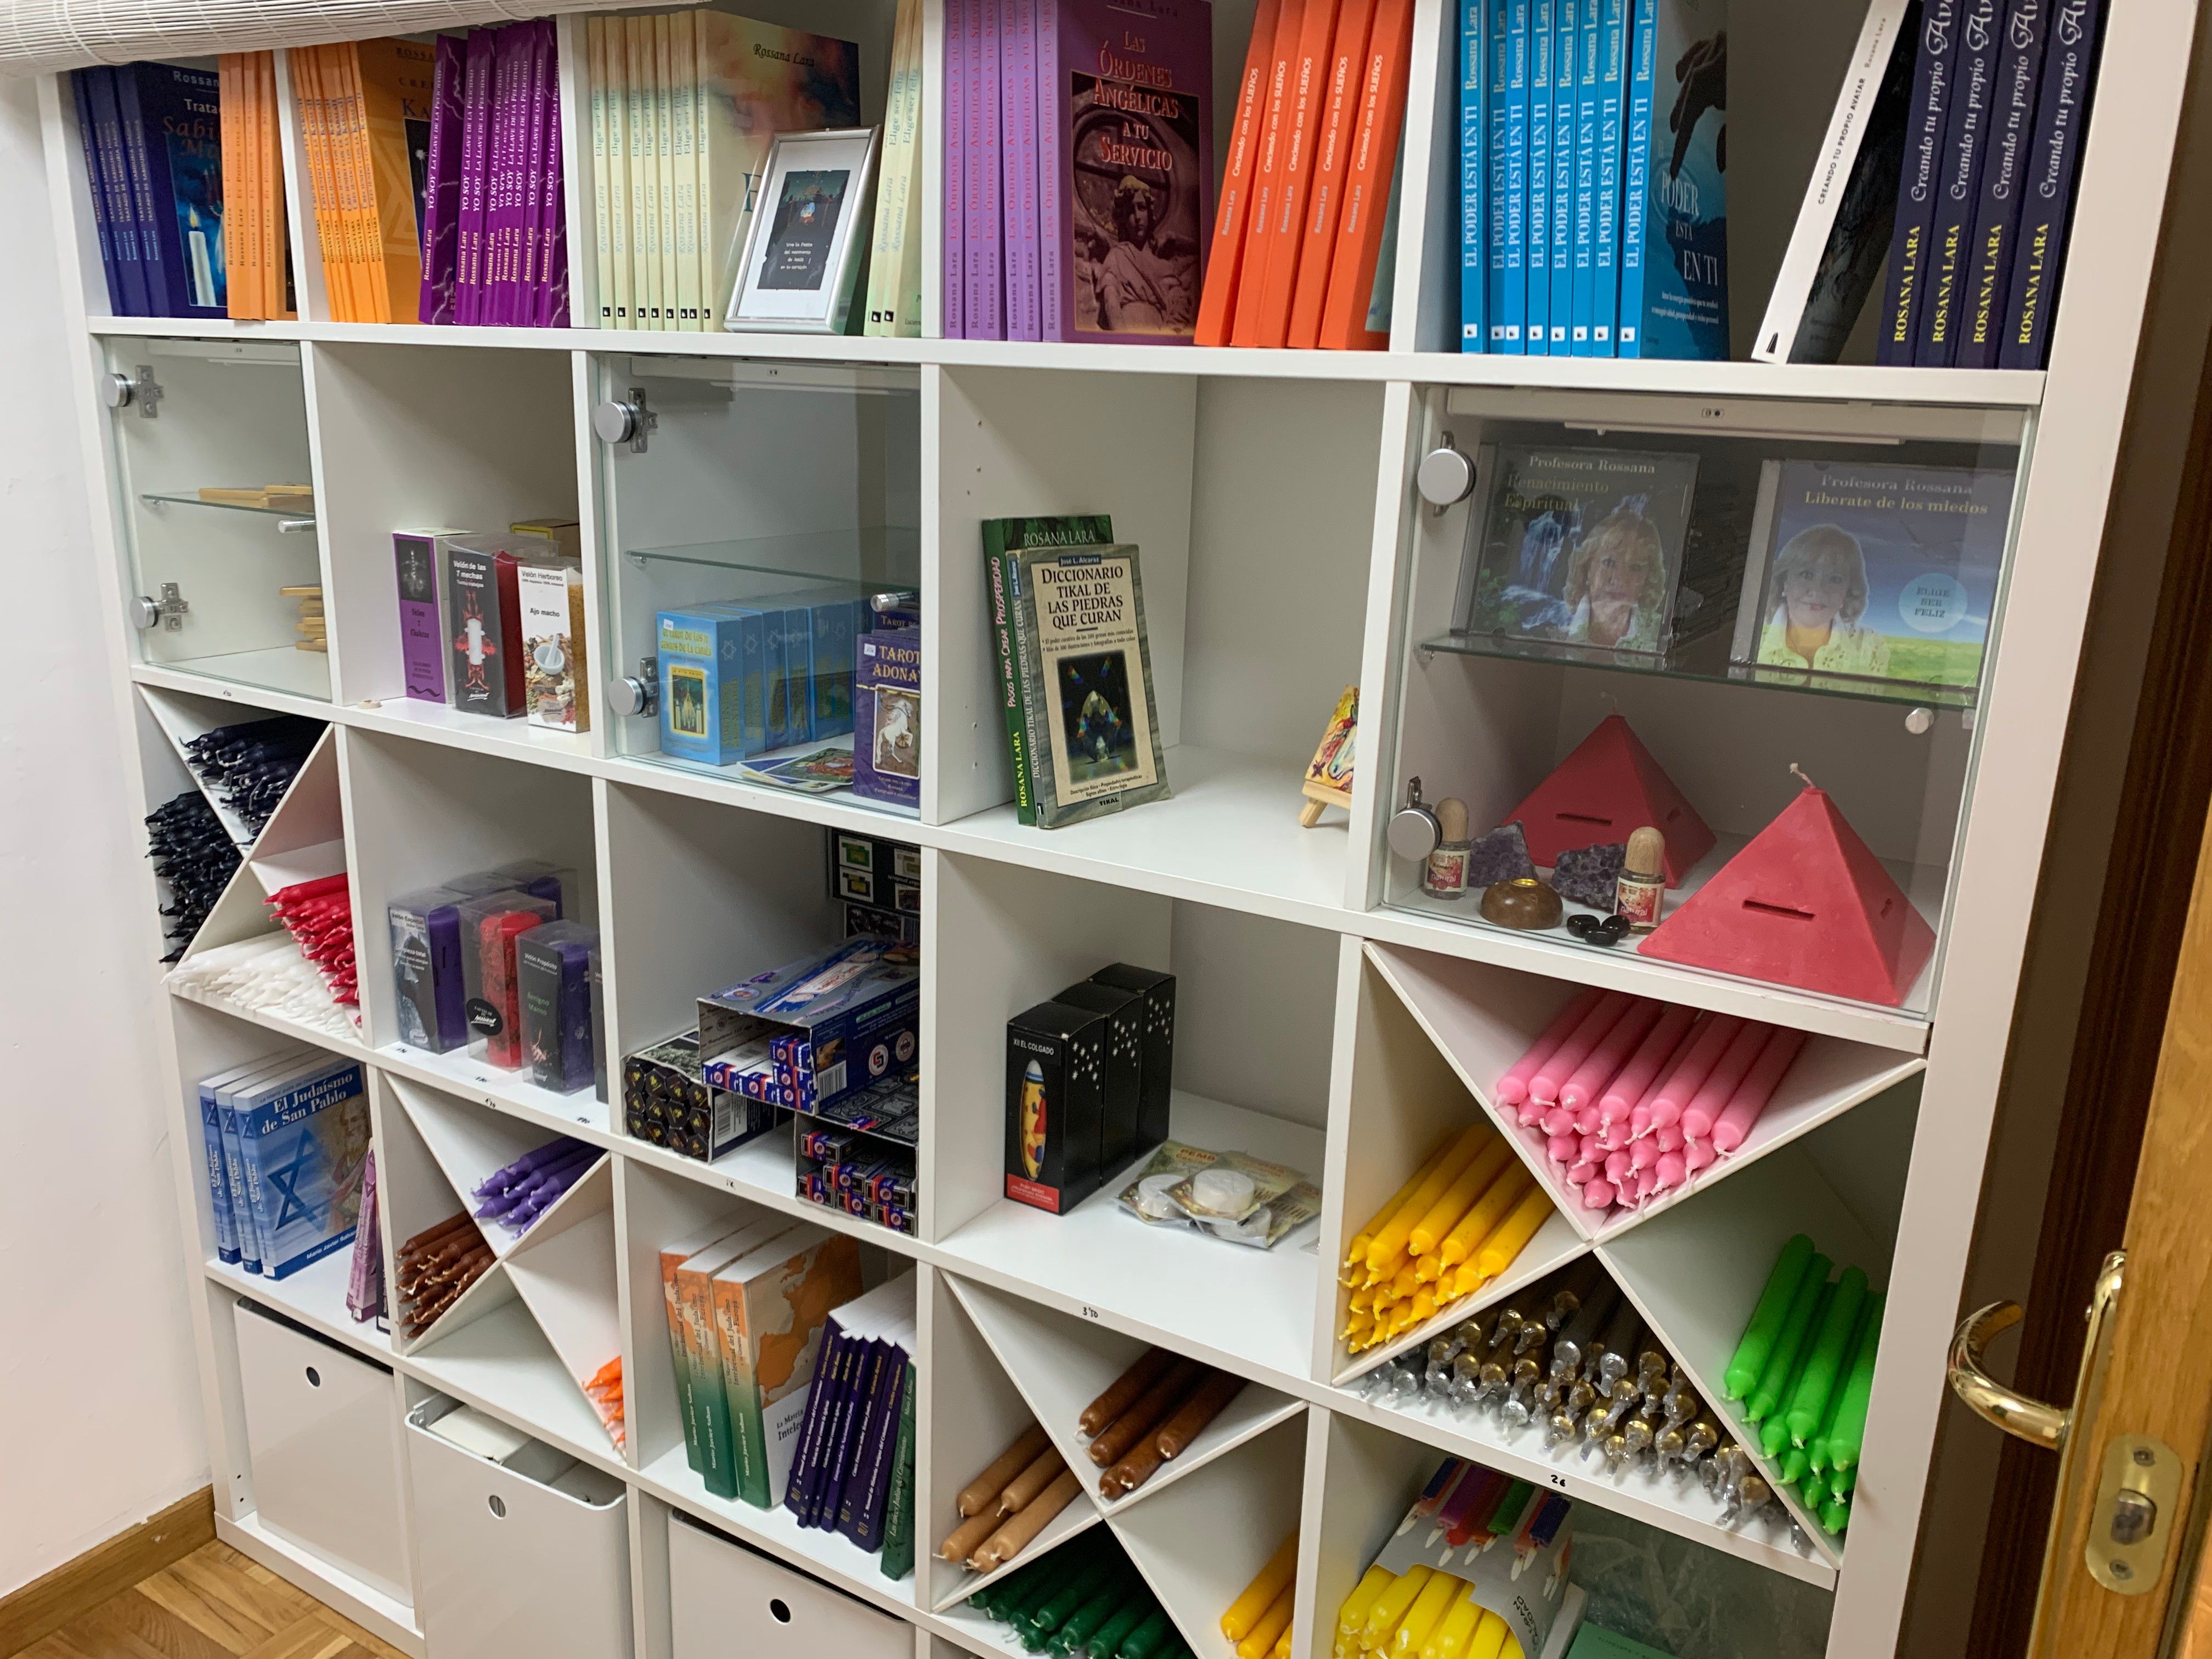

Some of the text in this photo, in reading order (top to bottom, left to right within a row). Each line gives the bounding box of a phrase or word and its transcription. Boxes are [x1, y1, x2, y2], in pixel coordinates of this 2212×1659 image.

[754, 44, 814, 67] Rossana Lara
[1465, 7, 1477, 89] Rossana Lara
[1510, 4, 1524, 88] Rossana Lara
[1101, 40, 1172, 88] ÓRDENES
[1369, 55, 1382, 92] SUEÑOS
[1274, 61, 1286, 97] SUEÑOS
[1093, 78, 1178, 119] ANGÉLICAS
[1272, 99, 1280, 112] los
[1367, 94, 1376, 108] los
[889, 117, 900, 145] Elige
[1123, 121, 1149, 139] A TU
[1910, 61, 1945, 201] Creando tu propio
[1950, 58, 1985, 199] Creando tu propio
[2040, 53, 2078, 198] Creando tu propio
[1101, 135, 1172, 171] SERVICIO
[1264, 132, 1276, 173] Creciendo
[1357, 128, 1370, 170] Creciendo
[1818, 78, 1865, 204] CREANDO TU PROPIO AVATAR
[464, 160, 470, 170] LA
[1462, 105, 1477, 266] EL PODER ESTÁ EN TI
[1506, 105, 1522, 267] EL PODER ESTÁ EN TI
[1661, 171, 1699, 220] PODER
[462, 197, 469, 210] YO
[949, 218, 957, 239] LAS
[1684, 250, 1718, 286] EN TI
[1894, 226, 1920, 341] ROSANA LARA
[1932, 225, 1960, 342] ROSANA LARA
[2019, 224, 2048, 343] ROSANA LARA
[1530, 455, 1655, 473] Profesora Rossana
[1821, 475, 1974, 494] Profesora Rossana
[1876, 496, 1895, 509] de
[1900, 497, 1923, 510] los
[1928, 500, 1988, 514] miedos
[1024, 529, 1096, 547] ROSANA LARA
[1060, 558, 1071, 566] José
[1042, 566, 1123, 584] DICCIONARIO
[1057, 583, 1110, 599] TIKAL DE
[530, 608, 560, 617] Ajo macho
[1048, 595, 1123, 614] LAS PIEDRAS
[1915, 608, 1945, 618] FELIZ
[1053, 610, 1121, 630] QUE CURAN
[879, 645, 920, 663] TAROT
[873, 663, 920, 682] ADONA
[1013, 732, 1027, 806] ROSANA LARA
[1099, 798, 1119, 806] TIKAL
[1431, 874, 1456, 882] natural
[1621, 905, 1648, 917] natural
[1028, 1043, 1054, 1055] COLGADO
[274, 1074, 353, 1114] El Judaísmo
[262, 1090, 347, 1135] de San Pablo
